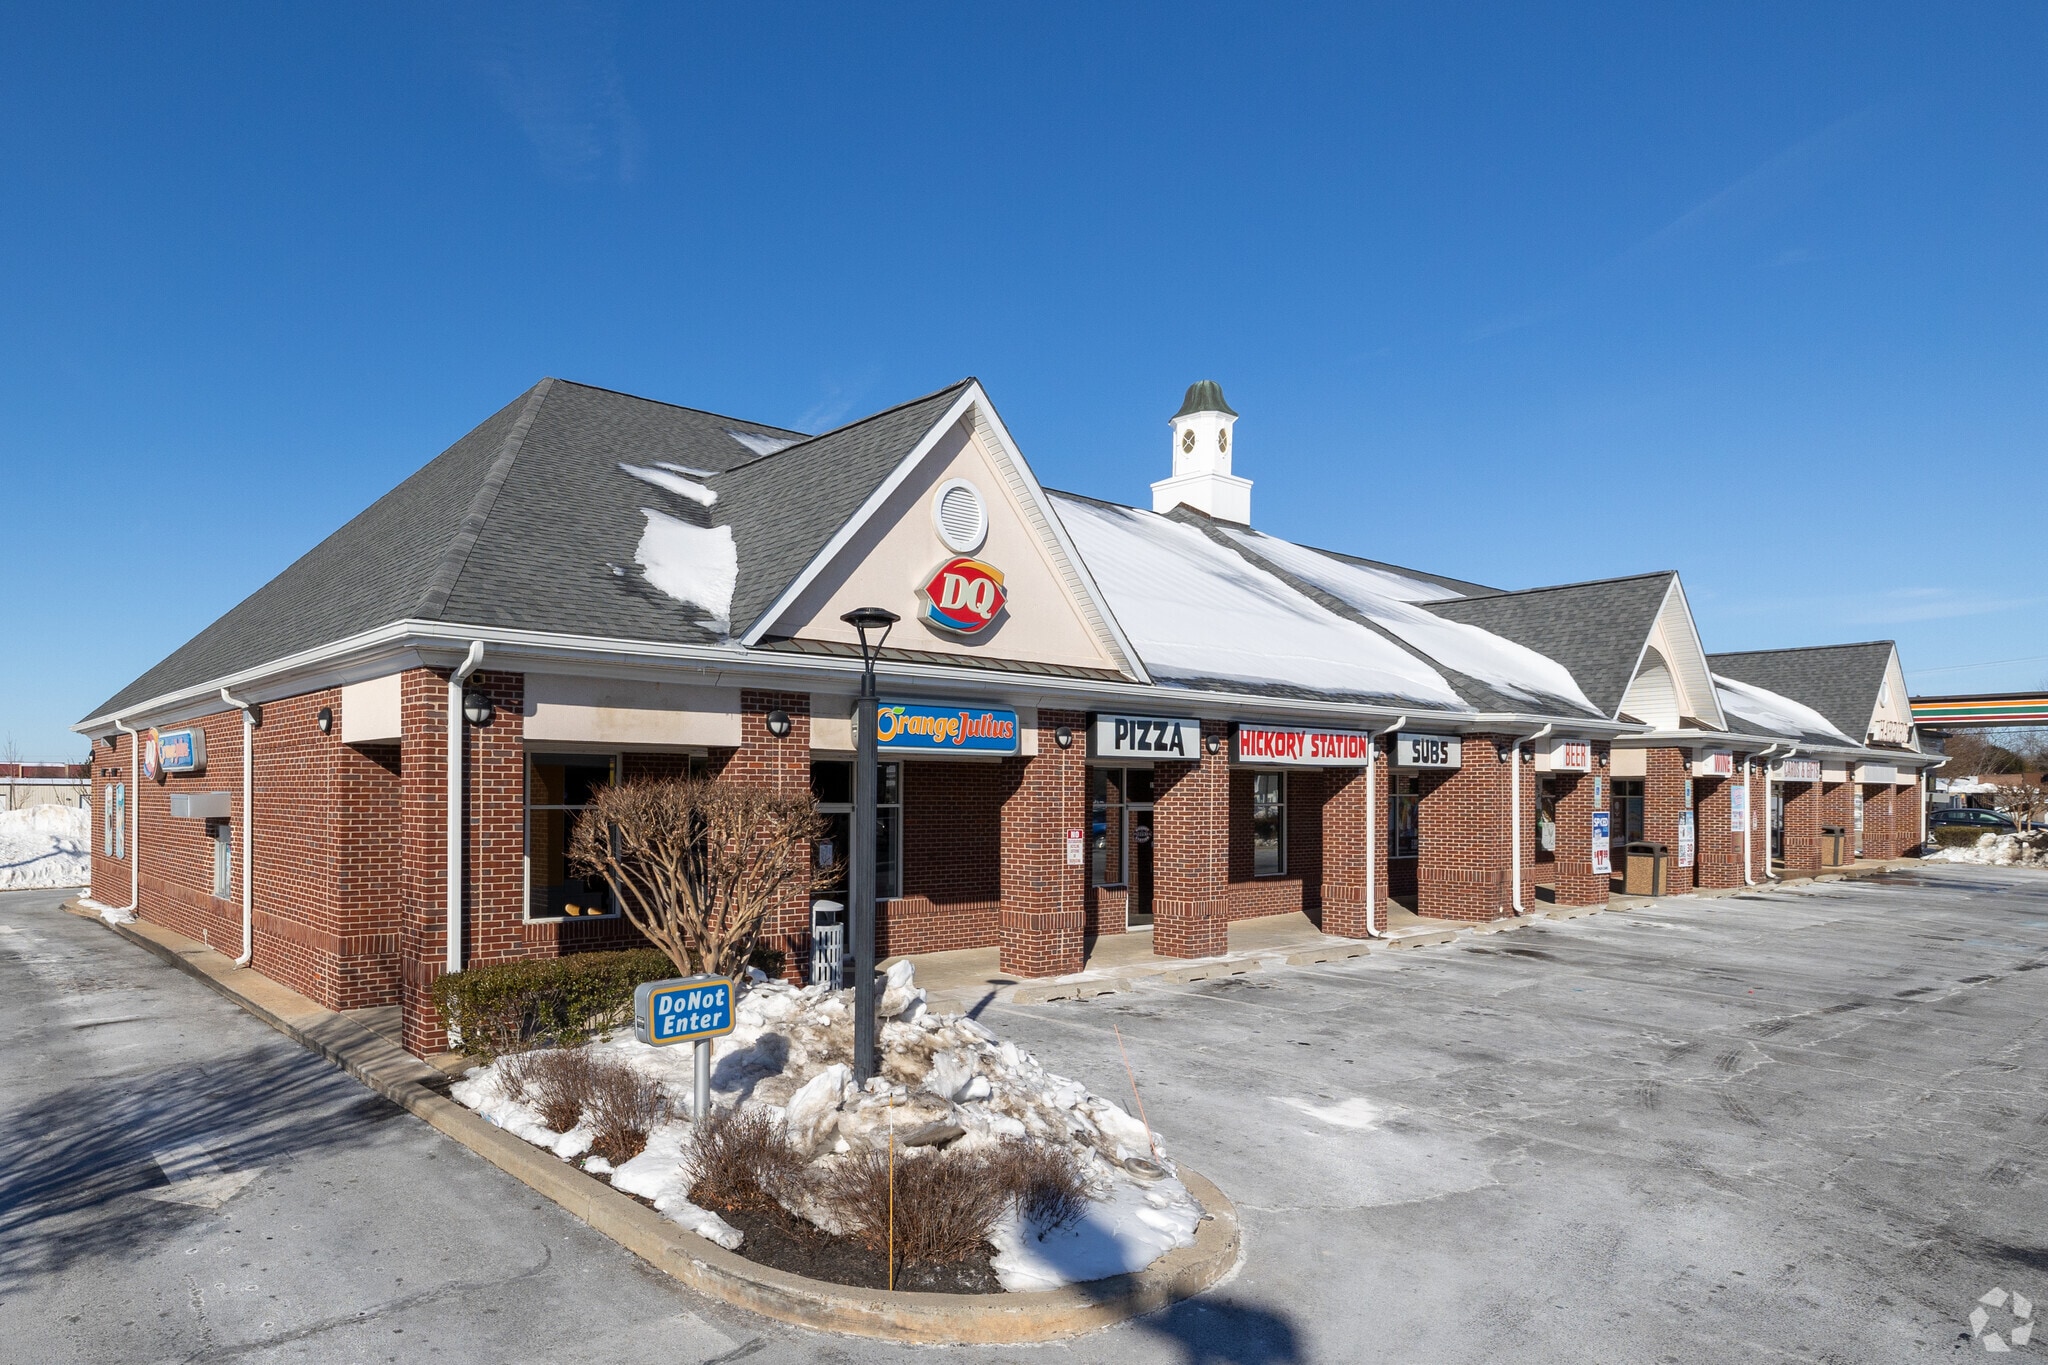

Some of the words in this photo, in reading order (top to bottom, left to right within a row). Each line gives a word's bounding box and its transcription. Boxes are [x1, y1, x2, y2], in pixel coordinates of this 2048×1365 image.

[940, 573, 995, 619] DQ
[1114, 717, 1185, 757] PIZZA
[1239, 729, 1306, 760] HICKORY
[1310, 733, 1367, 760] STATION
[1411, 738, 1449, 765] SUBS
[1566, 743, 1585, 765] BEER
[1714, 753, 1730, 773] WINE
[662, 1011, 722, 1036] Enter
